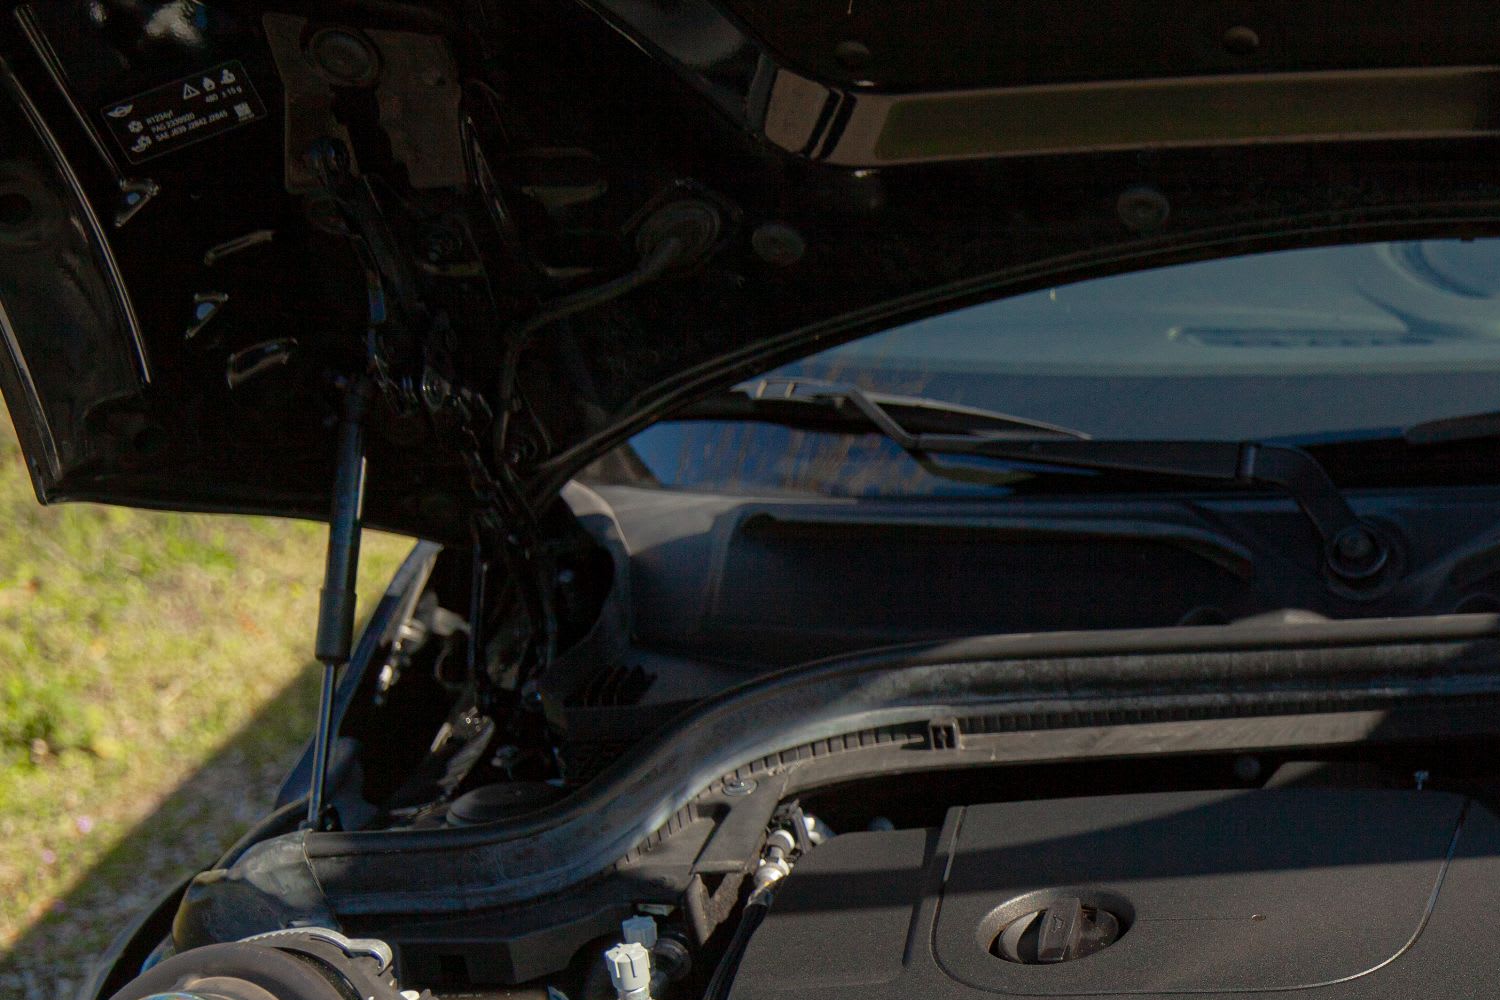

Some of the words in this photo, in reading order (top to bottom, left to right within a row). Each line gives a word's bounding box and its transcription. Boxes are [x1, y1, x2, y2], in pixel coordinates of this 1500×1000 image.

[151, 122, 166, 133] PAG
[155, 131, 169, 141] SAE
[171, 125, 187, 136] J639
